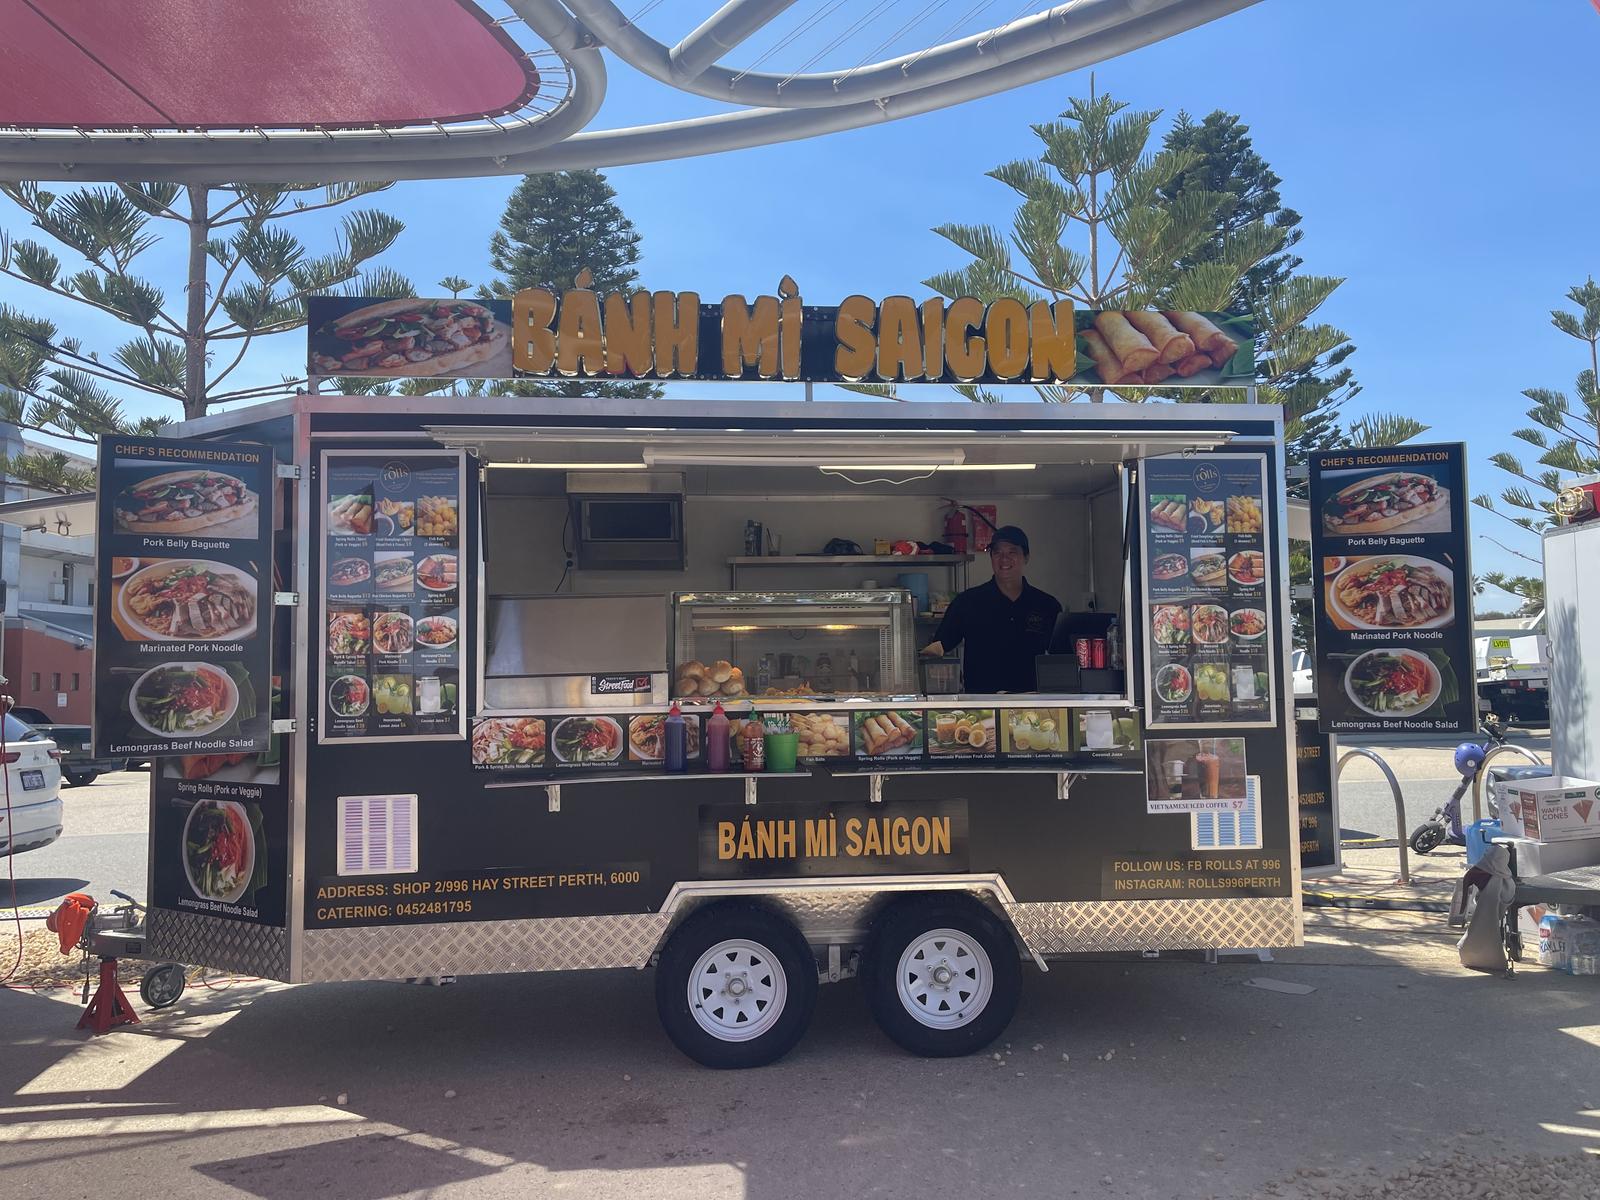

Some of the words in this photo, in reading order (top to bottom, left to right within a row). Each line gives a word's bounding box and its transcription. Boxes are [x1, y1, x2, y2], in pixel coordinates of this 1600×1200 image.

[835, 295, 1077, 385] SAIGON
[115, 444, 155, 456] CHEF'S
[158, 447, 260, 463] RECOMMENDATION
[1320, 455, 1355, 467] CHEF'S
[1356, 451, 1449, 466] RECOMMENDATION
[143, 538, 164, 547] Pork
[166, 539, 189, 550] Belly
[191, 539, 230, 550] Baguette
[1348, 537, 1367, 546] Pork
[1368, 537, 1389, 547] Belly
[1390, 536, 1425, 546] Baguette
[1350, 632, 1391, 640] Marinated
[1392, 631, 1411, 640] Pork
[1413, 630, 1443, 640] Noodle
[140, 643, 186, 652] Marinated
[188, 643, 209, 652] Pork
[212, 643, 244, 652] Noodle
[1331, 720, 1381, 730] Lemongrass
[1383, 720, 1402, 729] Beef
[1403, 720, 1433, 728] Noodle
[1434, 720, 1459, 728] Salad
[110, 743, 169, 755] Lemongrass
[171, 741, 193, 750] Beef
[194, 739, 227, 749] Noodle
[228, 738, 254, 748] Salad
[178, 782, 197, 794] Spring
[198, 784, 213, 794] Rolls
[214, 784, 230, 795] (Pork
[239, 786, 262, 798] Veggie)
[1232, 800, 1244, 809] $7
[1542, 812, 1568, 820] CONES
[718, 814, 797, 860] BÁNH
[804, 812, 837, 858] MÌ
[845, 816, 951, 857] SAIGON
[1114, 860, 1163, 873] FOLLOW
[1165, 860, 1184, 872] US:
[1187, 860, 1203, 871] FB
[1206, 860, 1243, 871] ROLLS
[1245, 860, 1260, 870] AT
[1262, 860, 1281, 870] 996
[316, 884, 388, 900] ADDRESS:
[393, 882, 432, 896] SHOP
[434, 880, 469, 894] 2/996
[472, 878, 500, 891] HAY
[502, 875, 556, 890] STREET
[559, 872, 607, 887] PERTH,
[610, 871, 640, 884] 6000
[1114, 878, 1185, 890] INSTAGRAM:
[1188, 877, 1281, 889] ROLLS996PERTH
[178, 896, 209, 910] Lemongrass
[210, 902, 222, 911] Beef
[222, 904, 242, 915] Noodle
[242, 906, 258, 918] Salad
[317, 904, 392, 920] CATERING:
[396, 900, 472, 916] 0452481795
